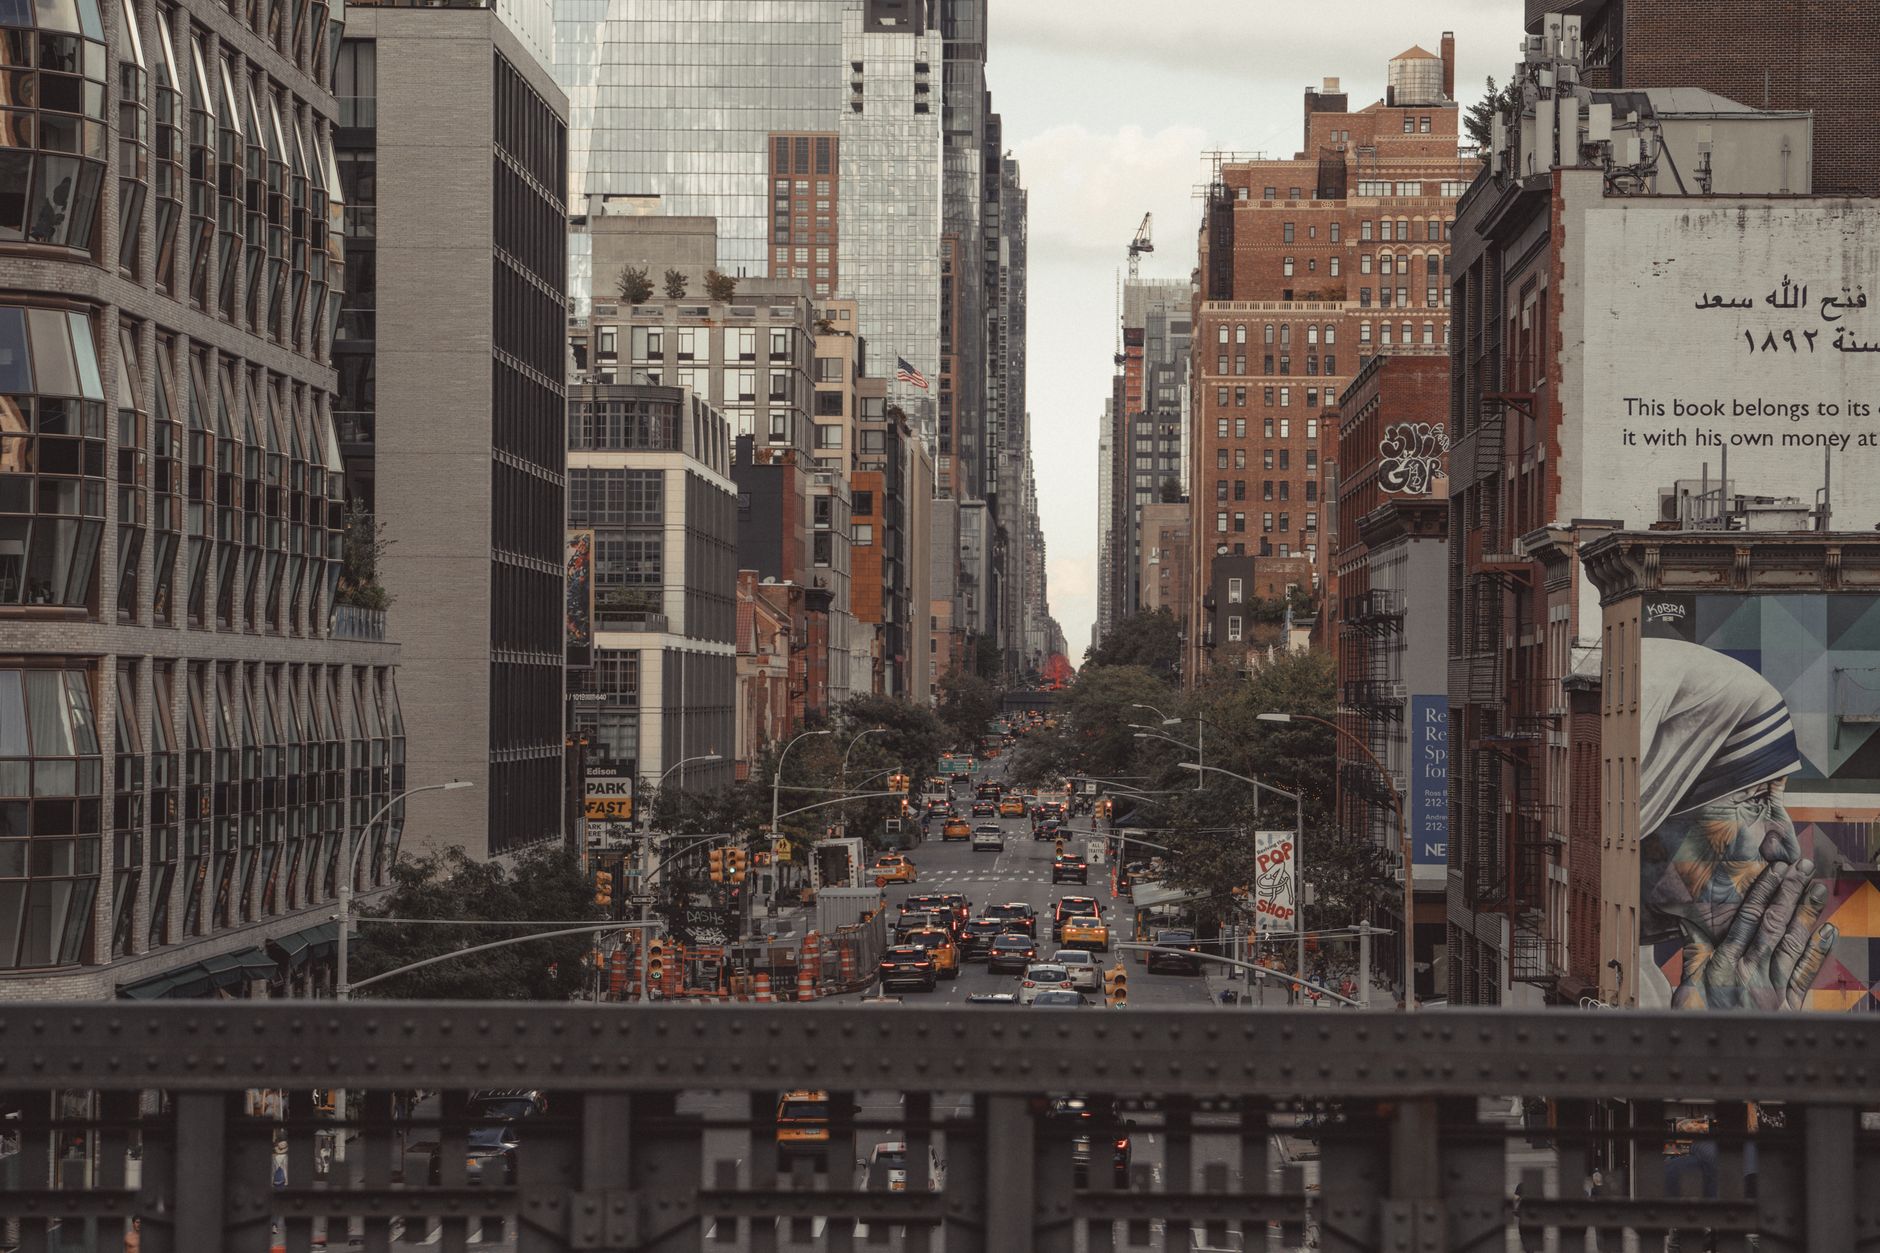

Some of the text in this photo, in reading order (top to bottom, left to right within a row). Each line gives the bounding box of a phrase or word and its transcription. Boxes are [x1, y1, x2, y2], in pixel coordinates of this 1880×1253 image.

[1695, 292, 1752, 309] سعد
[1821, 285, 1867, 321] فتح
[1745, 329, 1818, 354] ١٨٩٢
[1623, 398, 1665, 416] This
[1674, 399, 1725, 416] book
[1733, 398, 1810, 421] belongs
[1817, 402, 1839, 416] to
[1848, 399, 1870, 416] its
[1623, 428, 1878, 451] it with his own money at
[1646, 603, 1686, 616] KOBRA
[586, 767, 617, 775] Edison
[586, 782, 627, 794] PARK
[587, 801, 626, 813] FAST
[1425, 822, 1448, 831] 212-
[1256, 842, 1292, 872] POP
[1425, 843, 1448, 857] NE
[1257, 899, 1294, 920] SHOP
